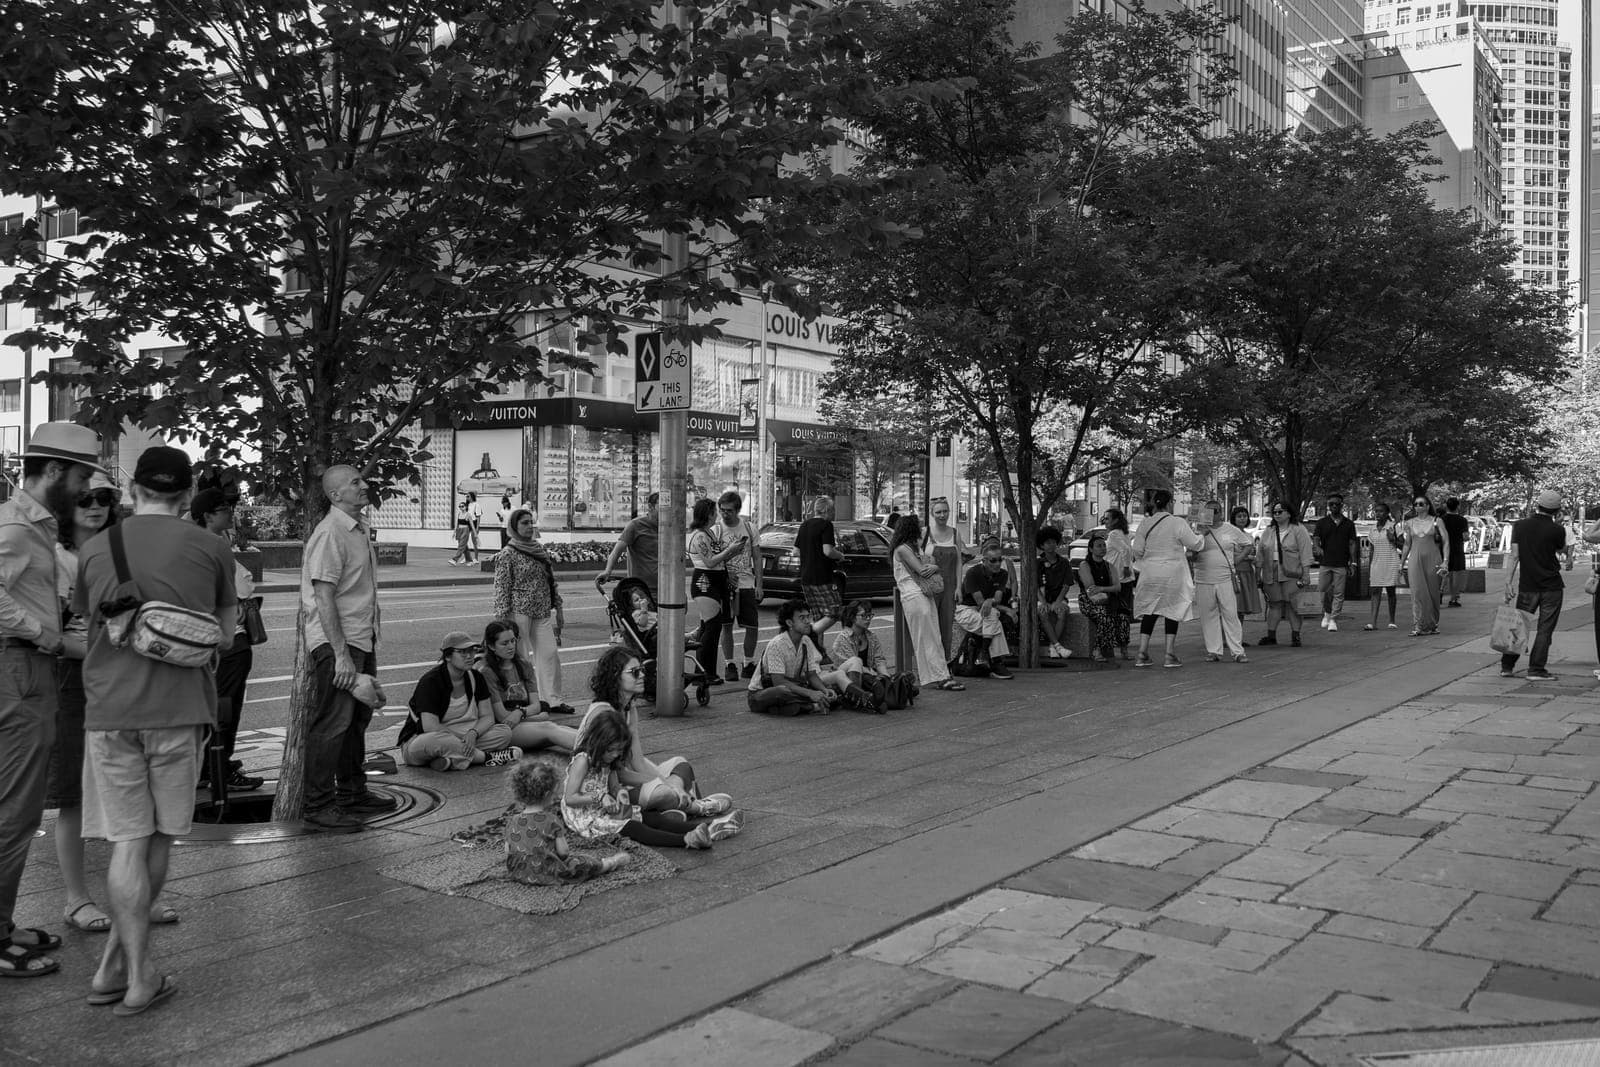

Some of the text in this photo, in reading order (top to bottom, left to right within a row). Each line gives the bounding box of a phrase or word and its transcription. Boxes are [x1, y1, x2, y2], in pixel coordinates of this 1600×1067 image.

[767, 312, 810, 340] LOUIS
[662, 382, 681, 394] THIS
[687, 417, 739, 433] OUIS VUITT
[791, 428, 814, 440] LOUIS
